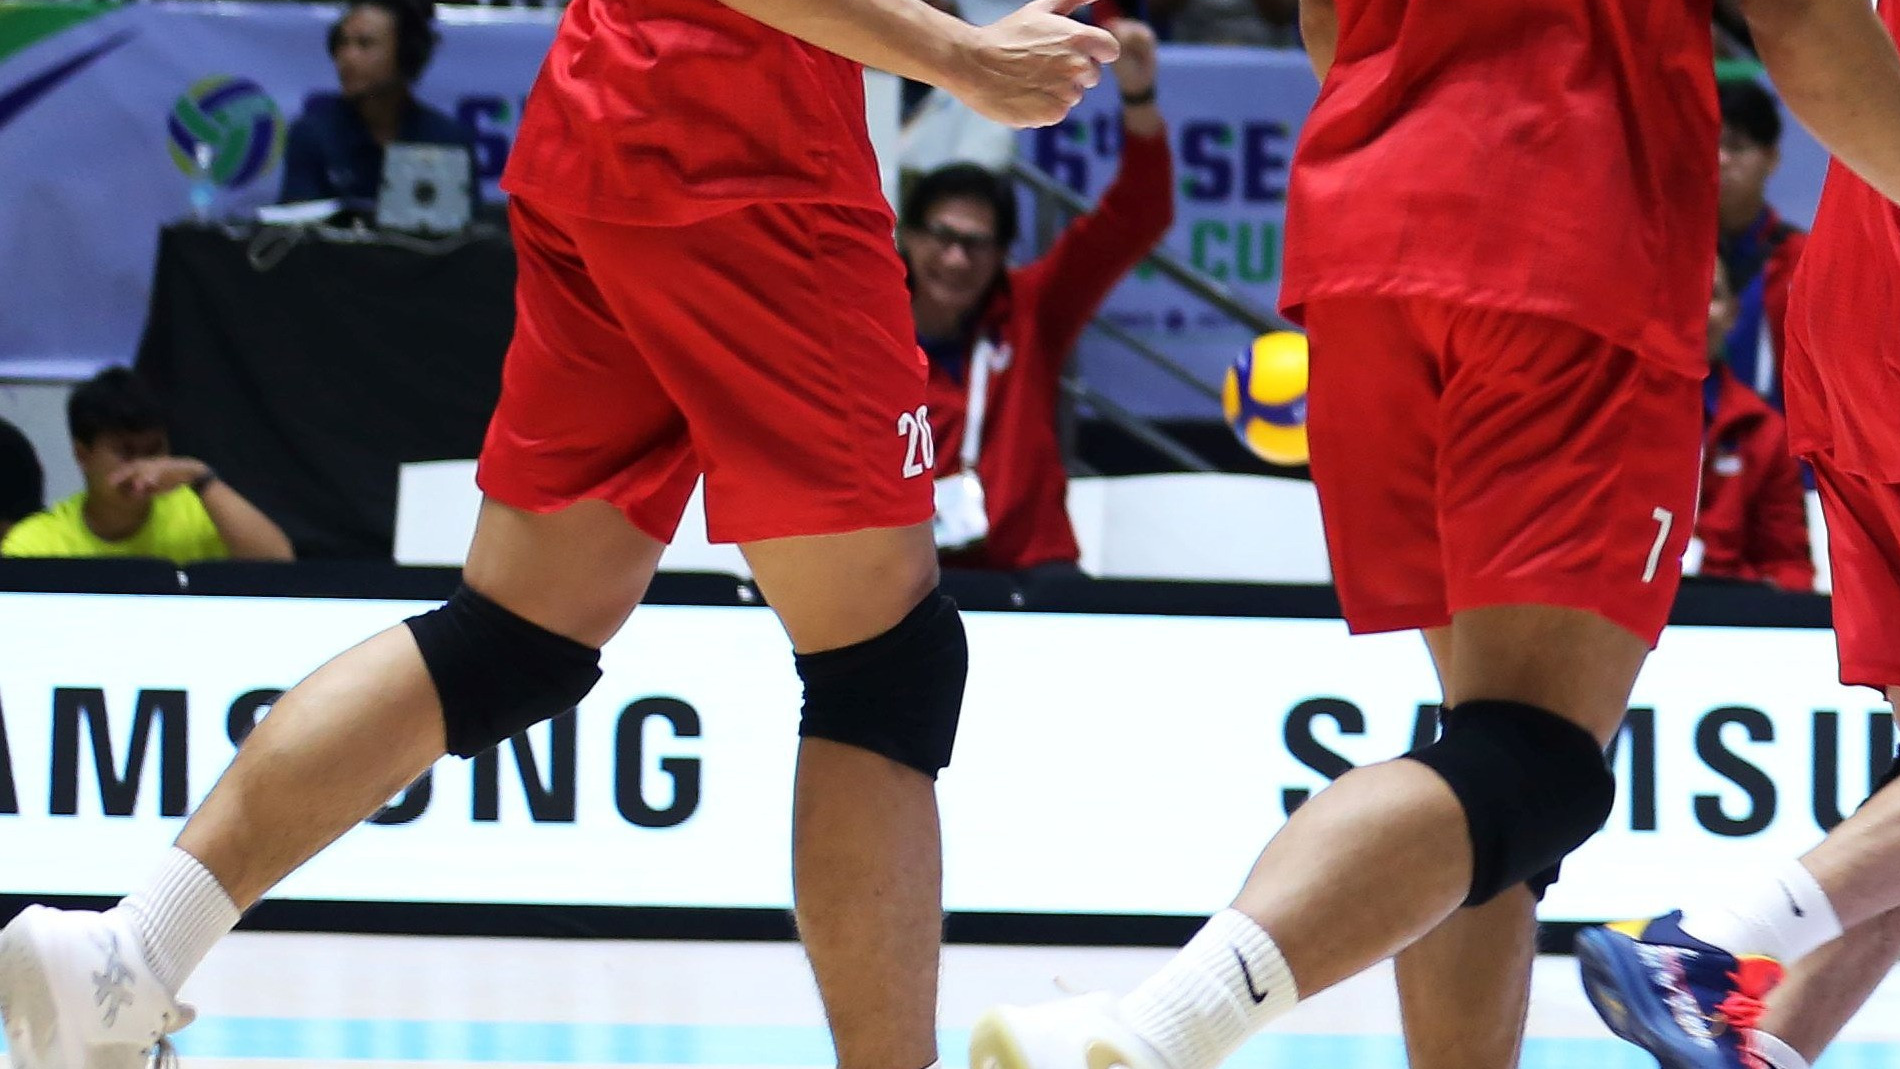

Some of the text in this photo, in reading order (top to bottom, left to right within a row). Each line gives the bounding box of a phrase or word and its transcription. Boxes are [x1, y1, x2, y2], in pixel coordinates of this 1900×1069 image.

[1181, 119, 1289, 201] SE
[1190, 219, 1279, 283] CU
[897, 405, 934, 479] 20
[1641, 507, 1674, 584] 7
